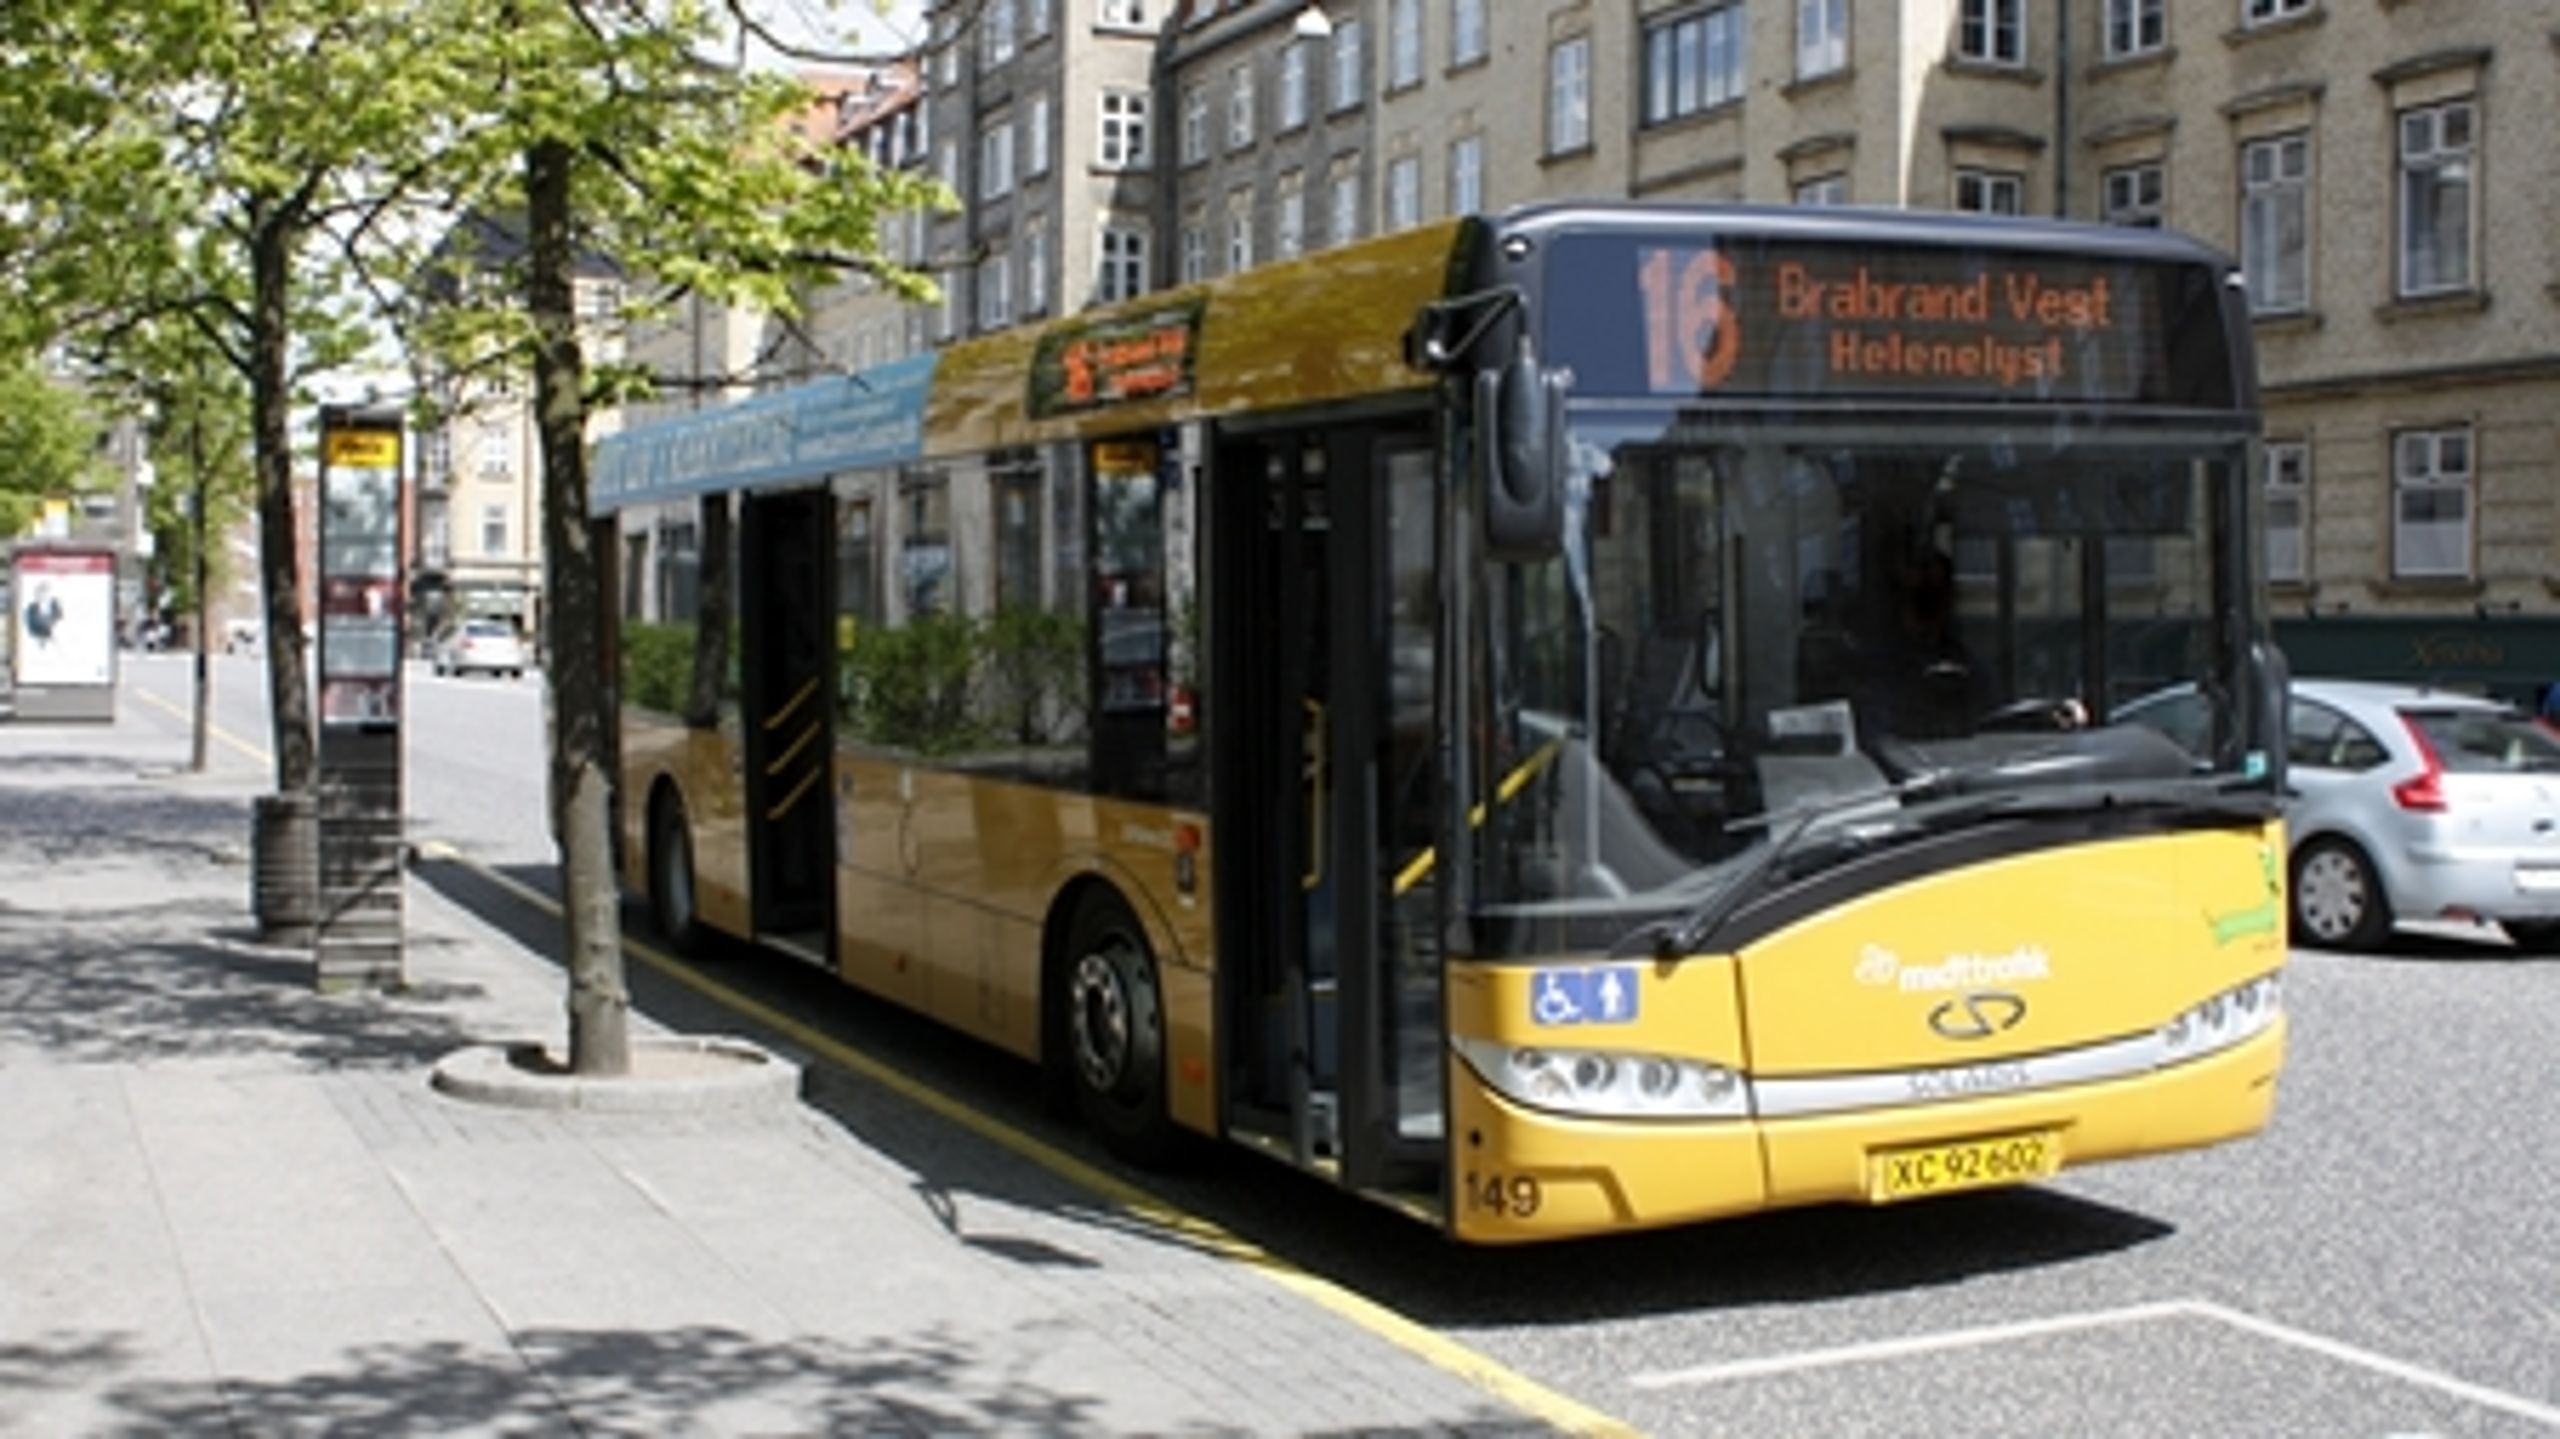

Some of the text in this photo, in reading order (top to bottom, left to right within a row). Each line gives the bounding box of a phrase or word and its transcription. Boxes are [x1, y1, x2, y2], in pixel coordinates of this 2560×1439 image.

[1638, 249, 1742, 387] 16
[1777, 263, 2112, 327] Brabrand Vest
[1829, 329, 2064, 386] Helenelyst
[1465, 1171, 1542, 1217] 149
[1893, 1154, 1936, 1190] XC
